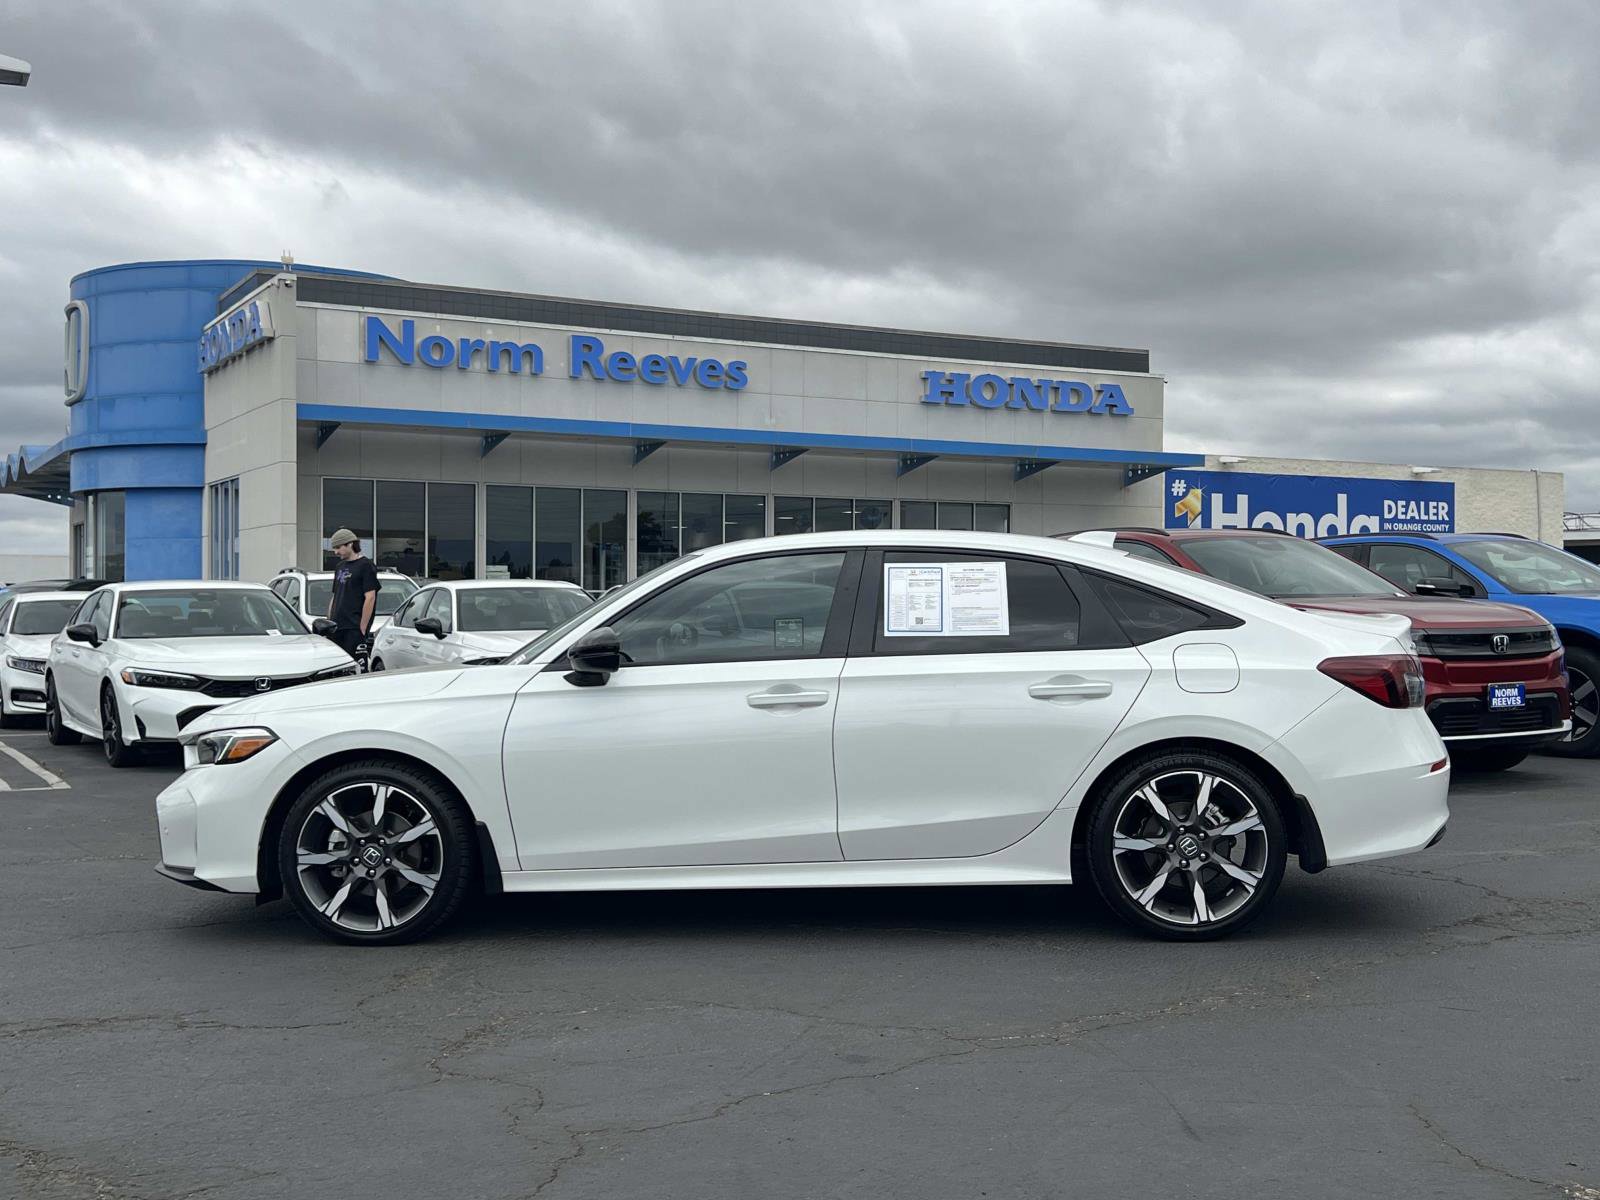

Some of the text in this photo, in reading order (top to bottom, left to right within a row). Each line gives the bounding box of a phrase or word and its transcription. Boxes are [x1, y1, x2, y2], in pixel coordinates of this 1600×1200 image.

[199, 300, 264, 373] HONDA
[364, 316, 749, 390] Norm Reeves
[921, 370, 1135, 416] HONDA
[1383, 500, 1450, 521] DEALER
[1383, 523, 1450, 532] IN ORANGE COUNTY
[1492, 697, 1522, 706] REEVES
[1494, 688, 1519, 698] NORM
